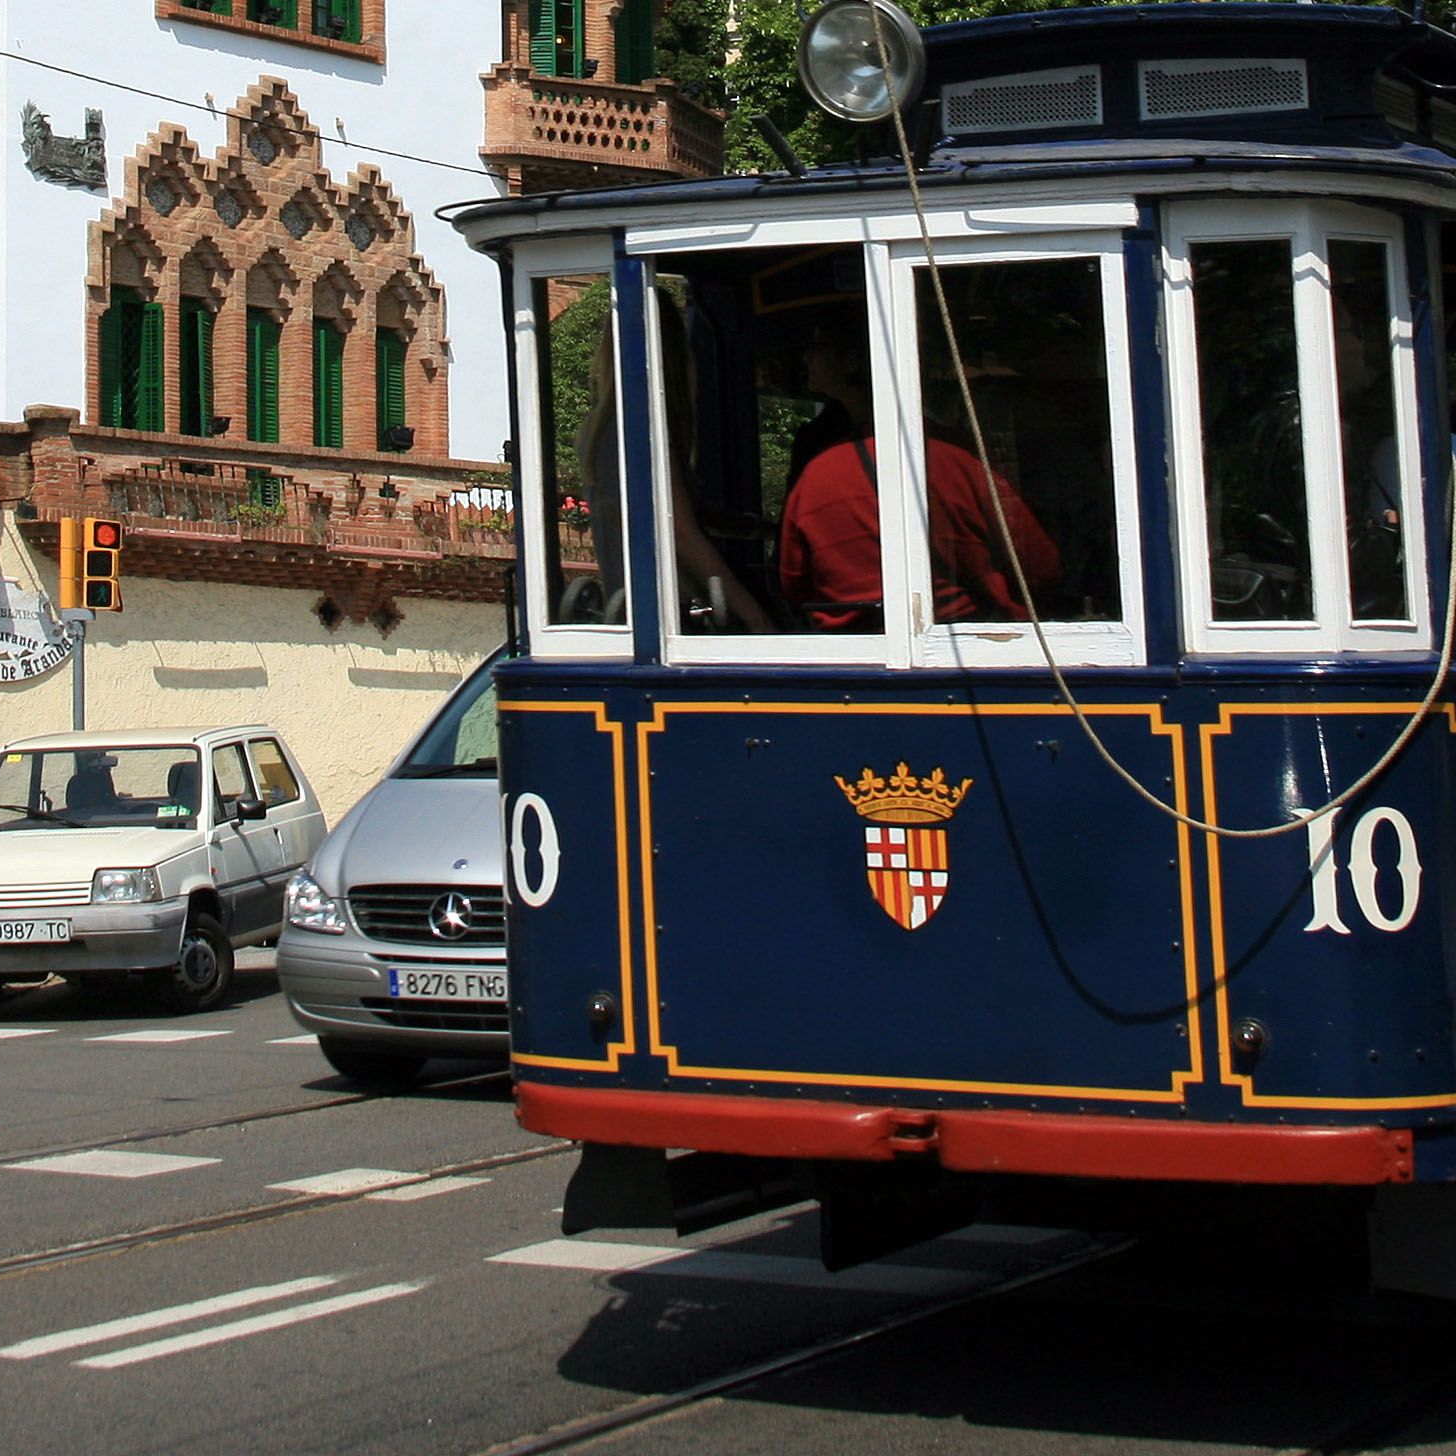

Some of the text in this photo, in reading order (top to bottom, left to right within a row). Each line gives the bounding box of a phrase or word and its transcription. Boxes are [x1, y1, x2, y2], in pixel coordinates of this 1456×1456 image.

[1, 662, 17, 681] de
[20, 638, 74, 677] Aranda
[1290, 806, 1423, 934] 10
[46, 922, 67, 940] TC
[406, 972, 505, 998] 8276 FNG
